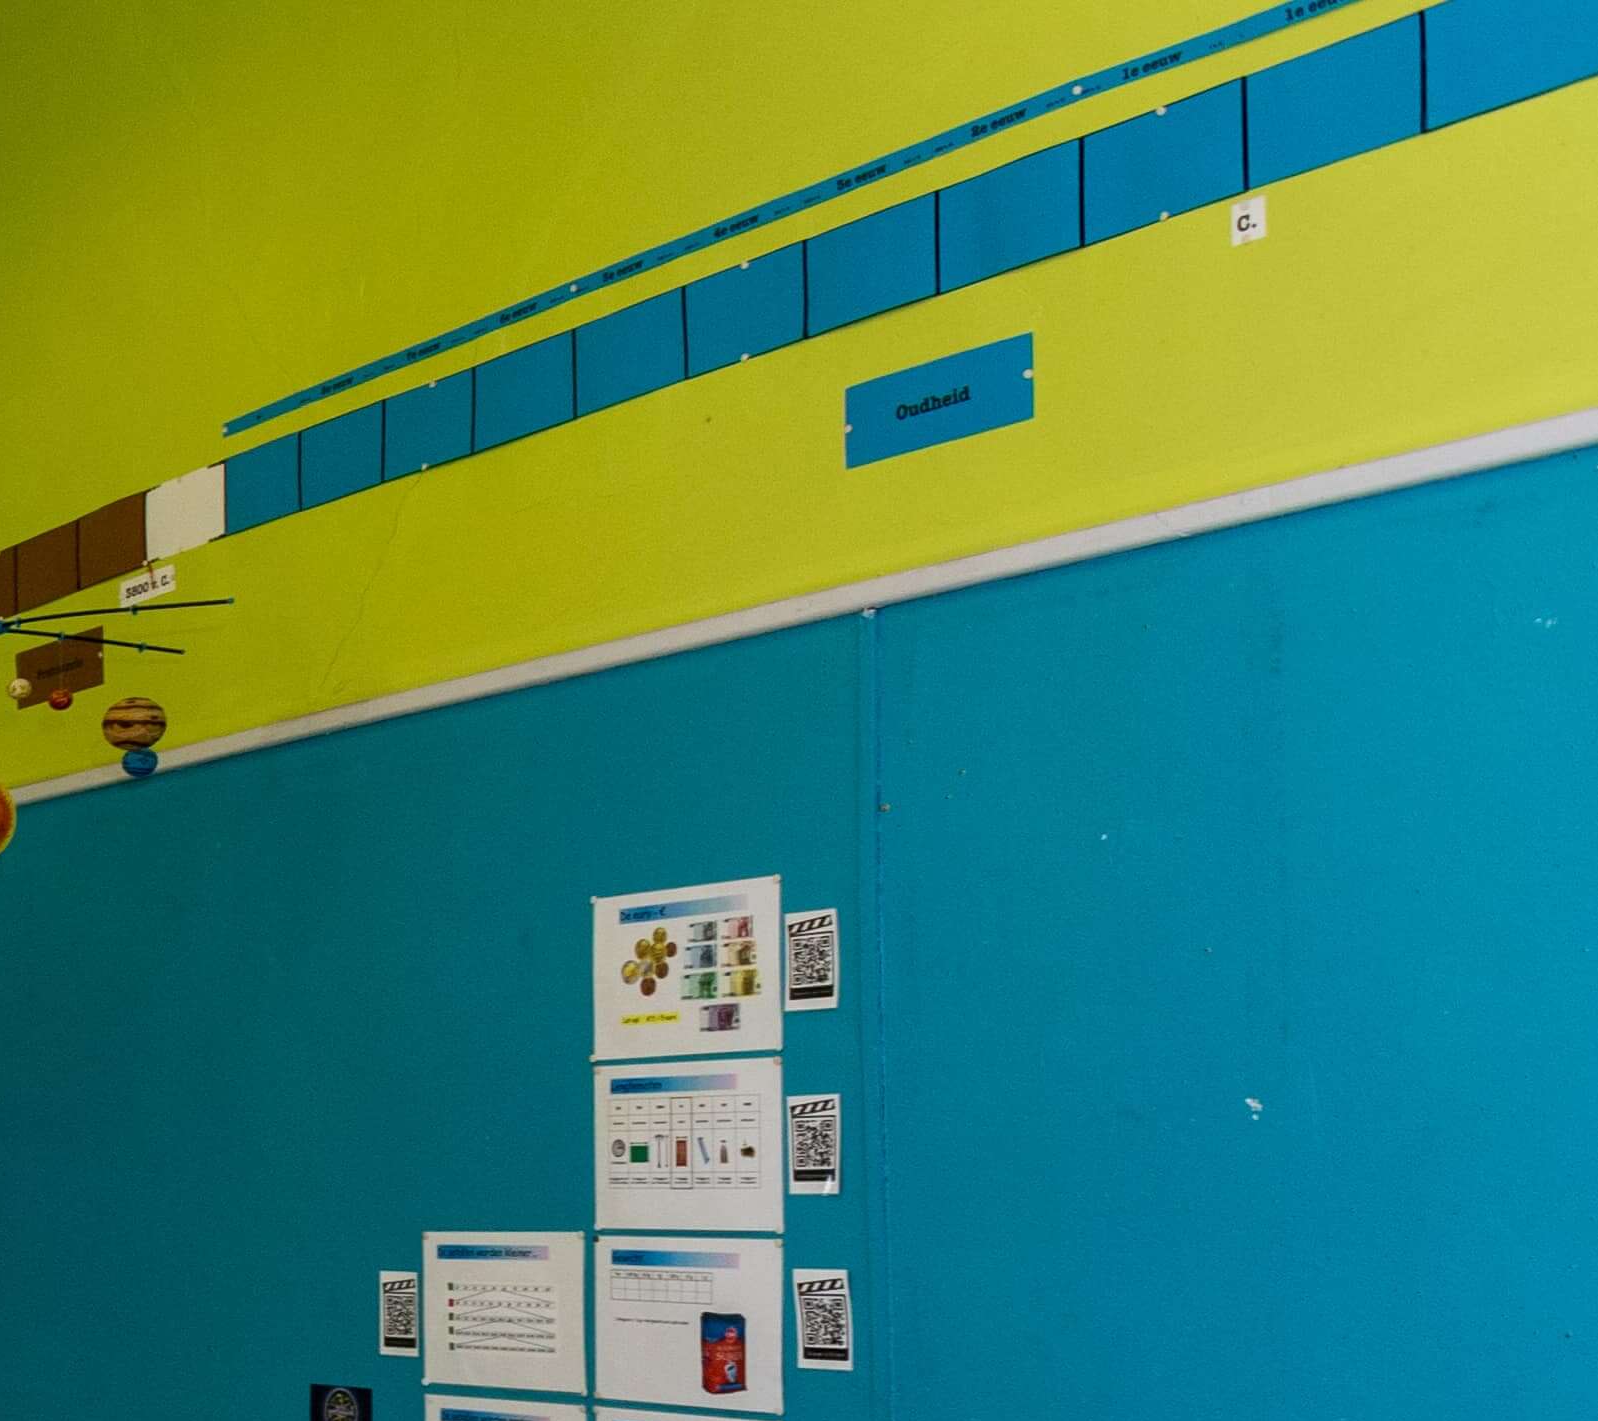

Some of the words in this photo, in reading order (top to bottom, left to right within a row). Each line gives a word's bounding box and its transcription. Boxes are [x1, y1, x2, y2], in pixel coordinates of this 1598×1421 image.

[1142, 50, 1182, 74] eeuw
[989, 108, 1027, 132] eeuw
[1237, 214, 1258, 233] C.
[894, 385, 972, 422] Oudheid
